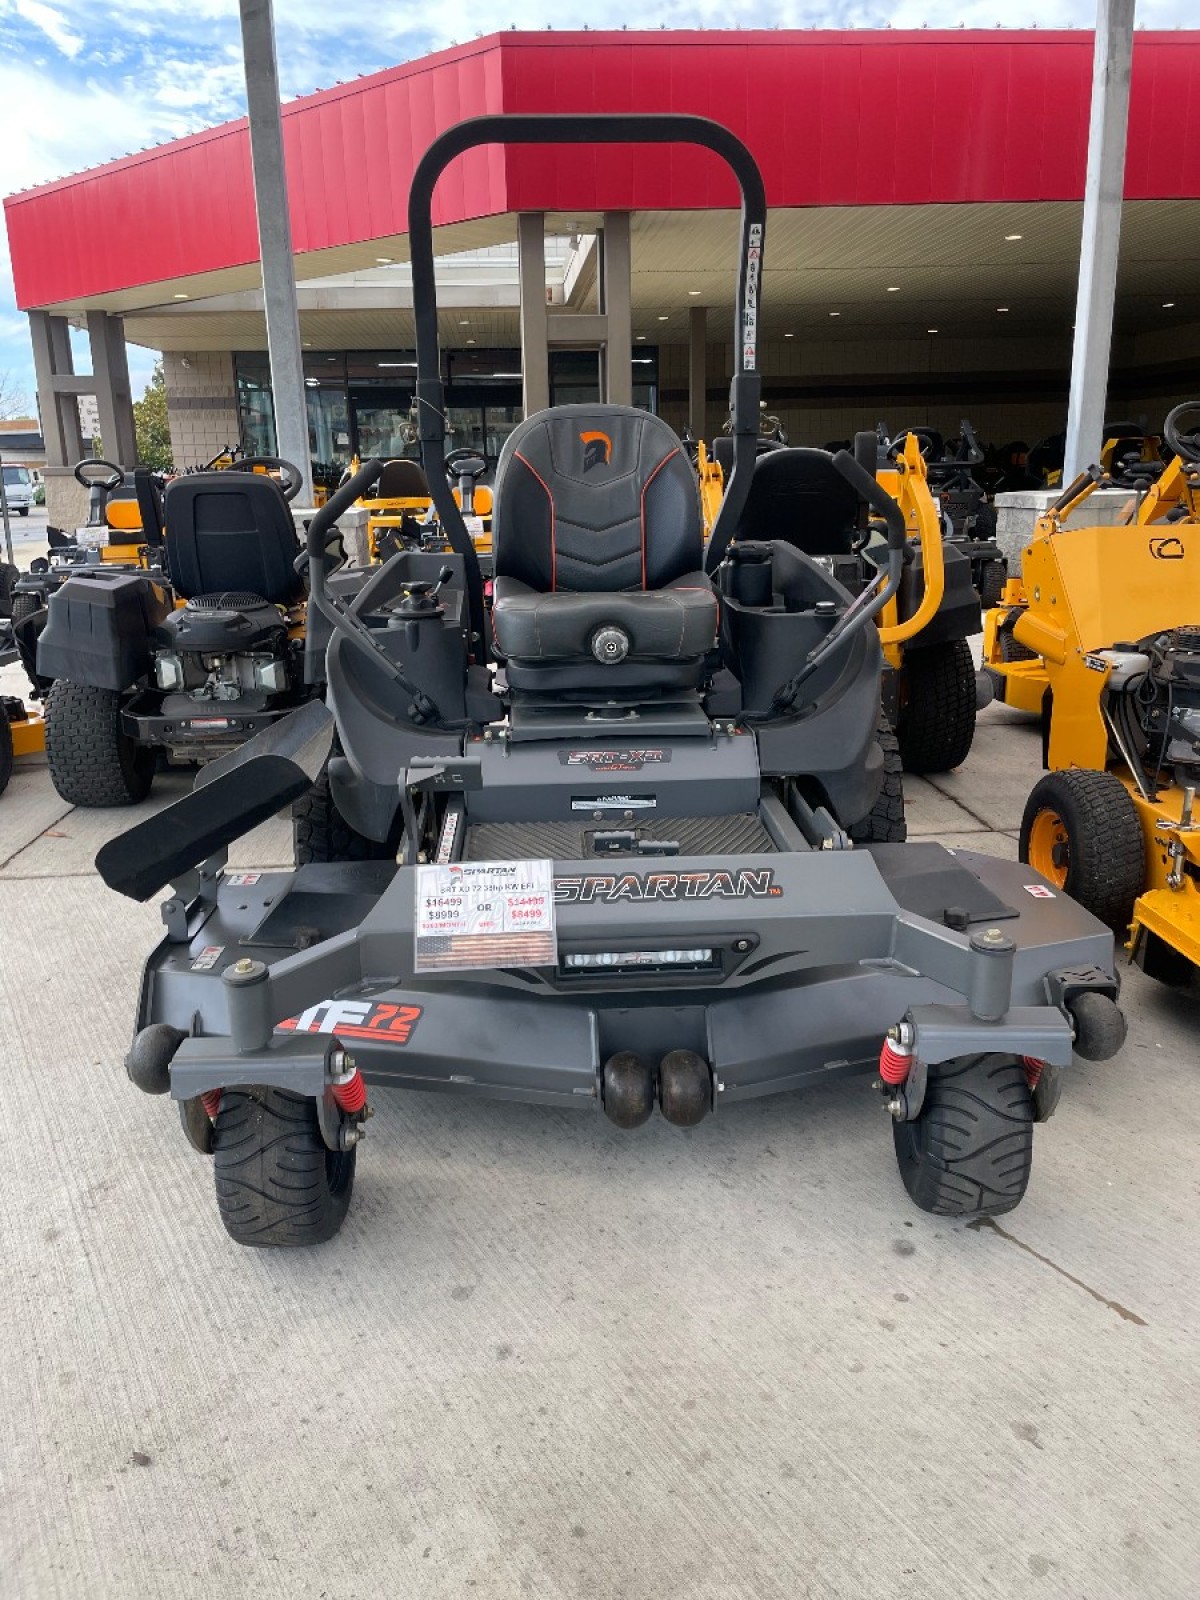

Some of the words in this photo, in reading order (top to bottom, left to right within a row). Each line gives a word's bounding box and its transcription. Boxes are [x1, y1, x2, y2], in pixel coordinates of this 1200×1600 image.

[463, 867, 517, 876] SPARTAN
[551, 871, 772, 902] SPARTAN
[476, 903, 492, 912] OR
[511, 909, 542, 920] $8499
